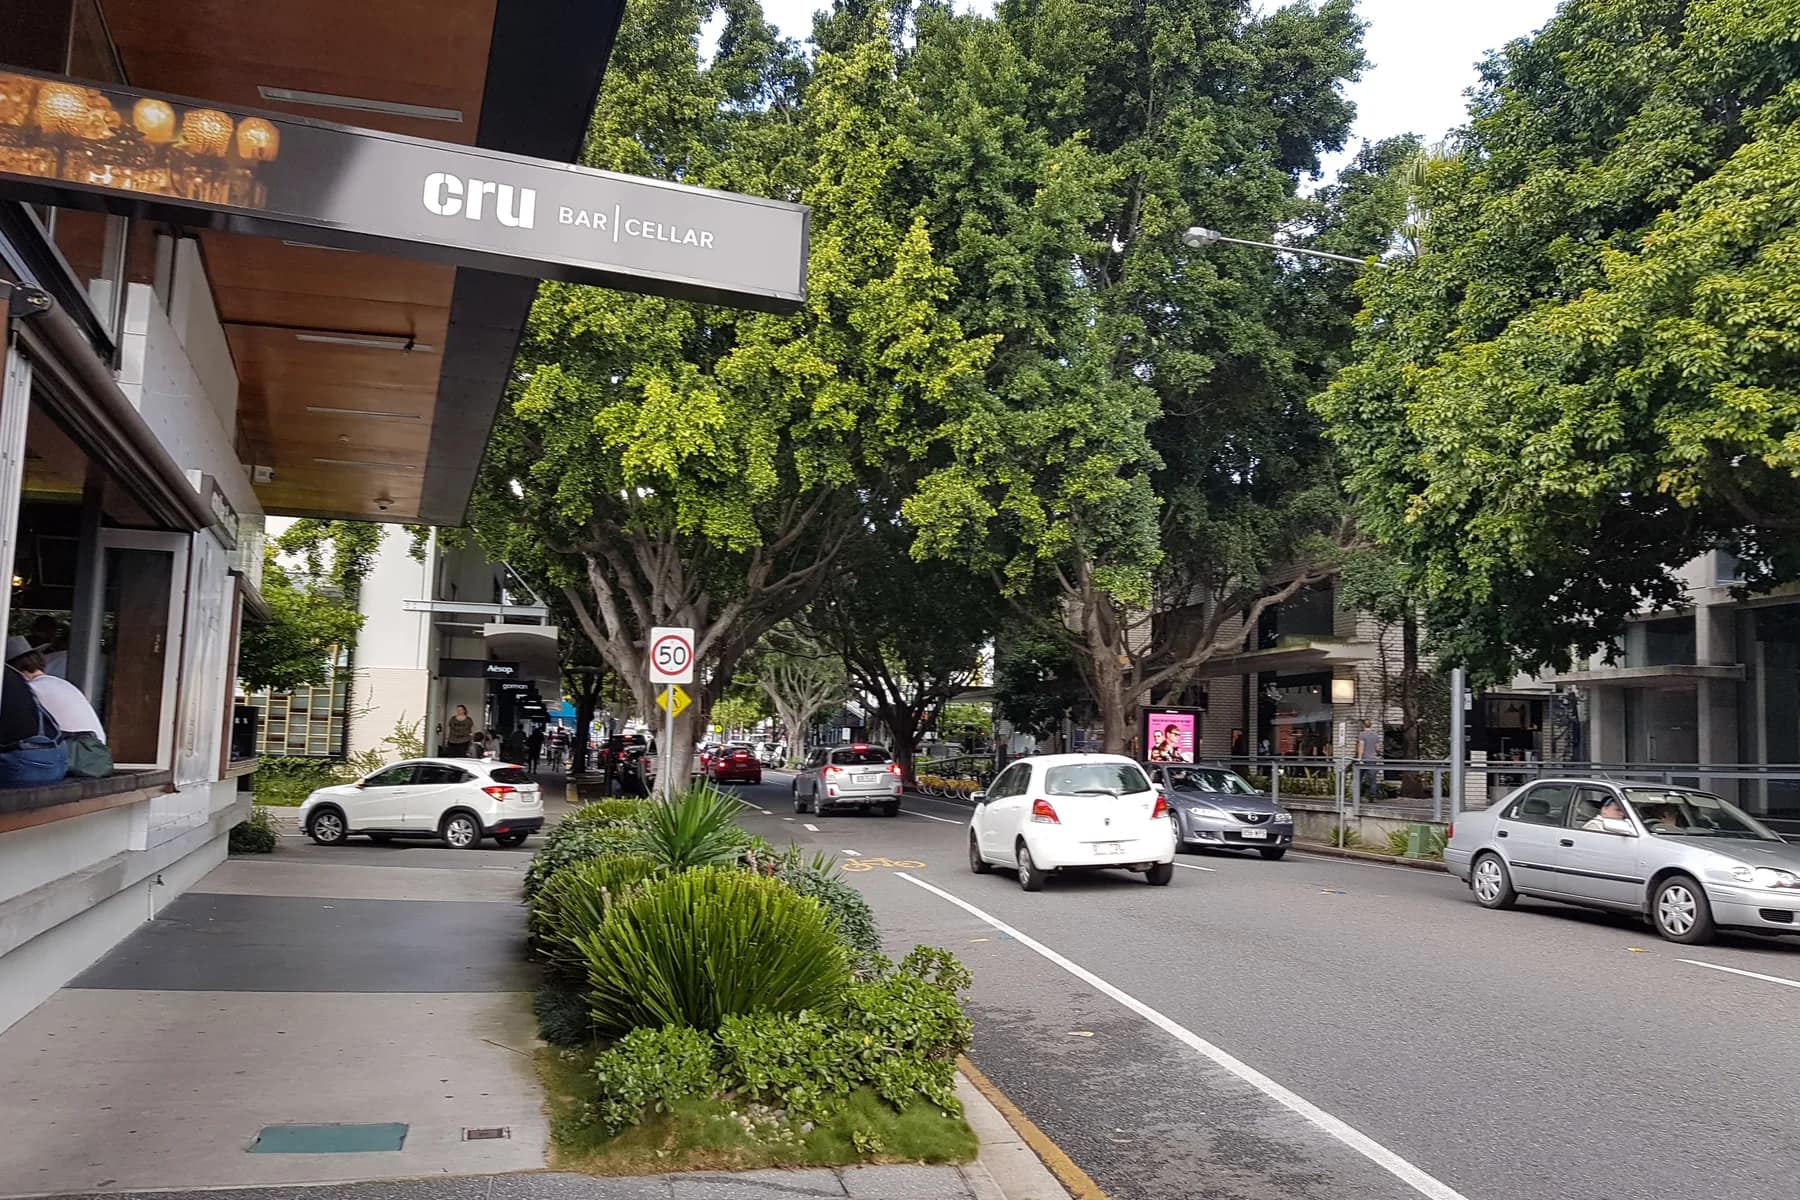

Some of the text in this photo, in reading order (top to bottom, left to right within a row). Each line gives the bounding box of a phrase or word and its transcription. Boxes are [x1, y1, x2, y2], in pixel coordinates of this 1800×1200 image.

[422, 172, 536, 230] cru
[558, 205, 715, 249] BAR CELLAR
[659, 645, 686, 666] 50
